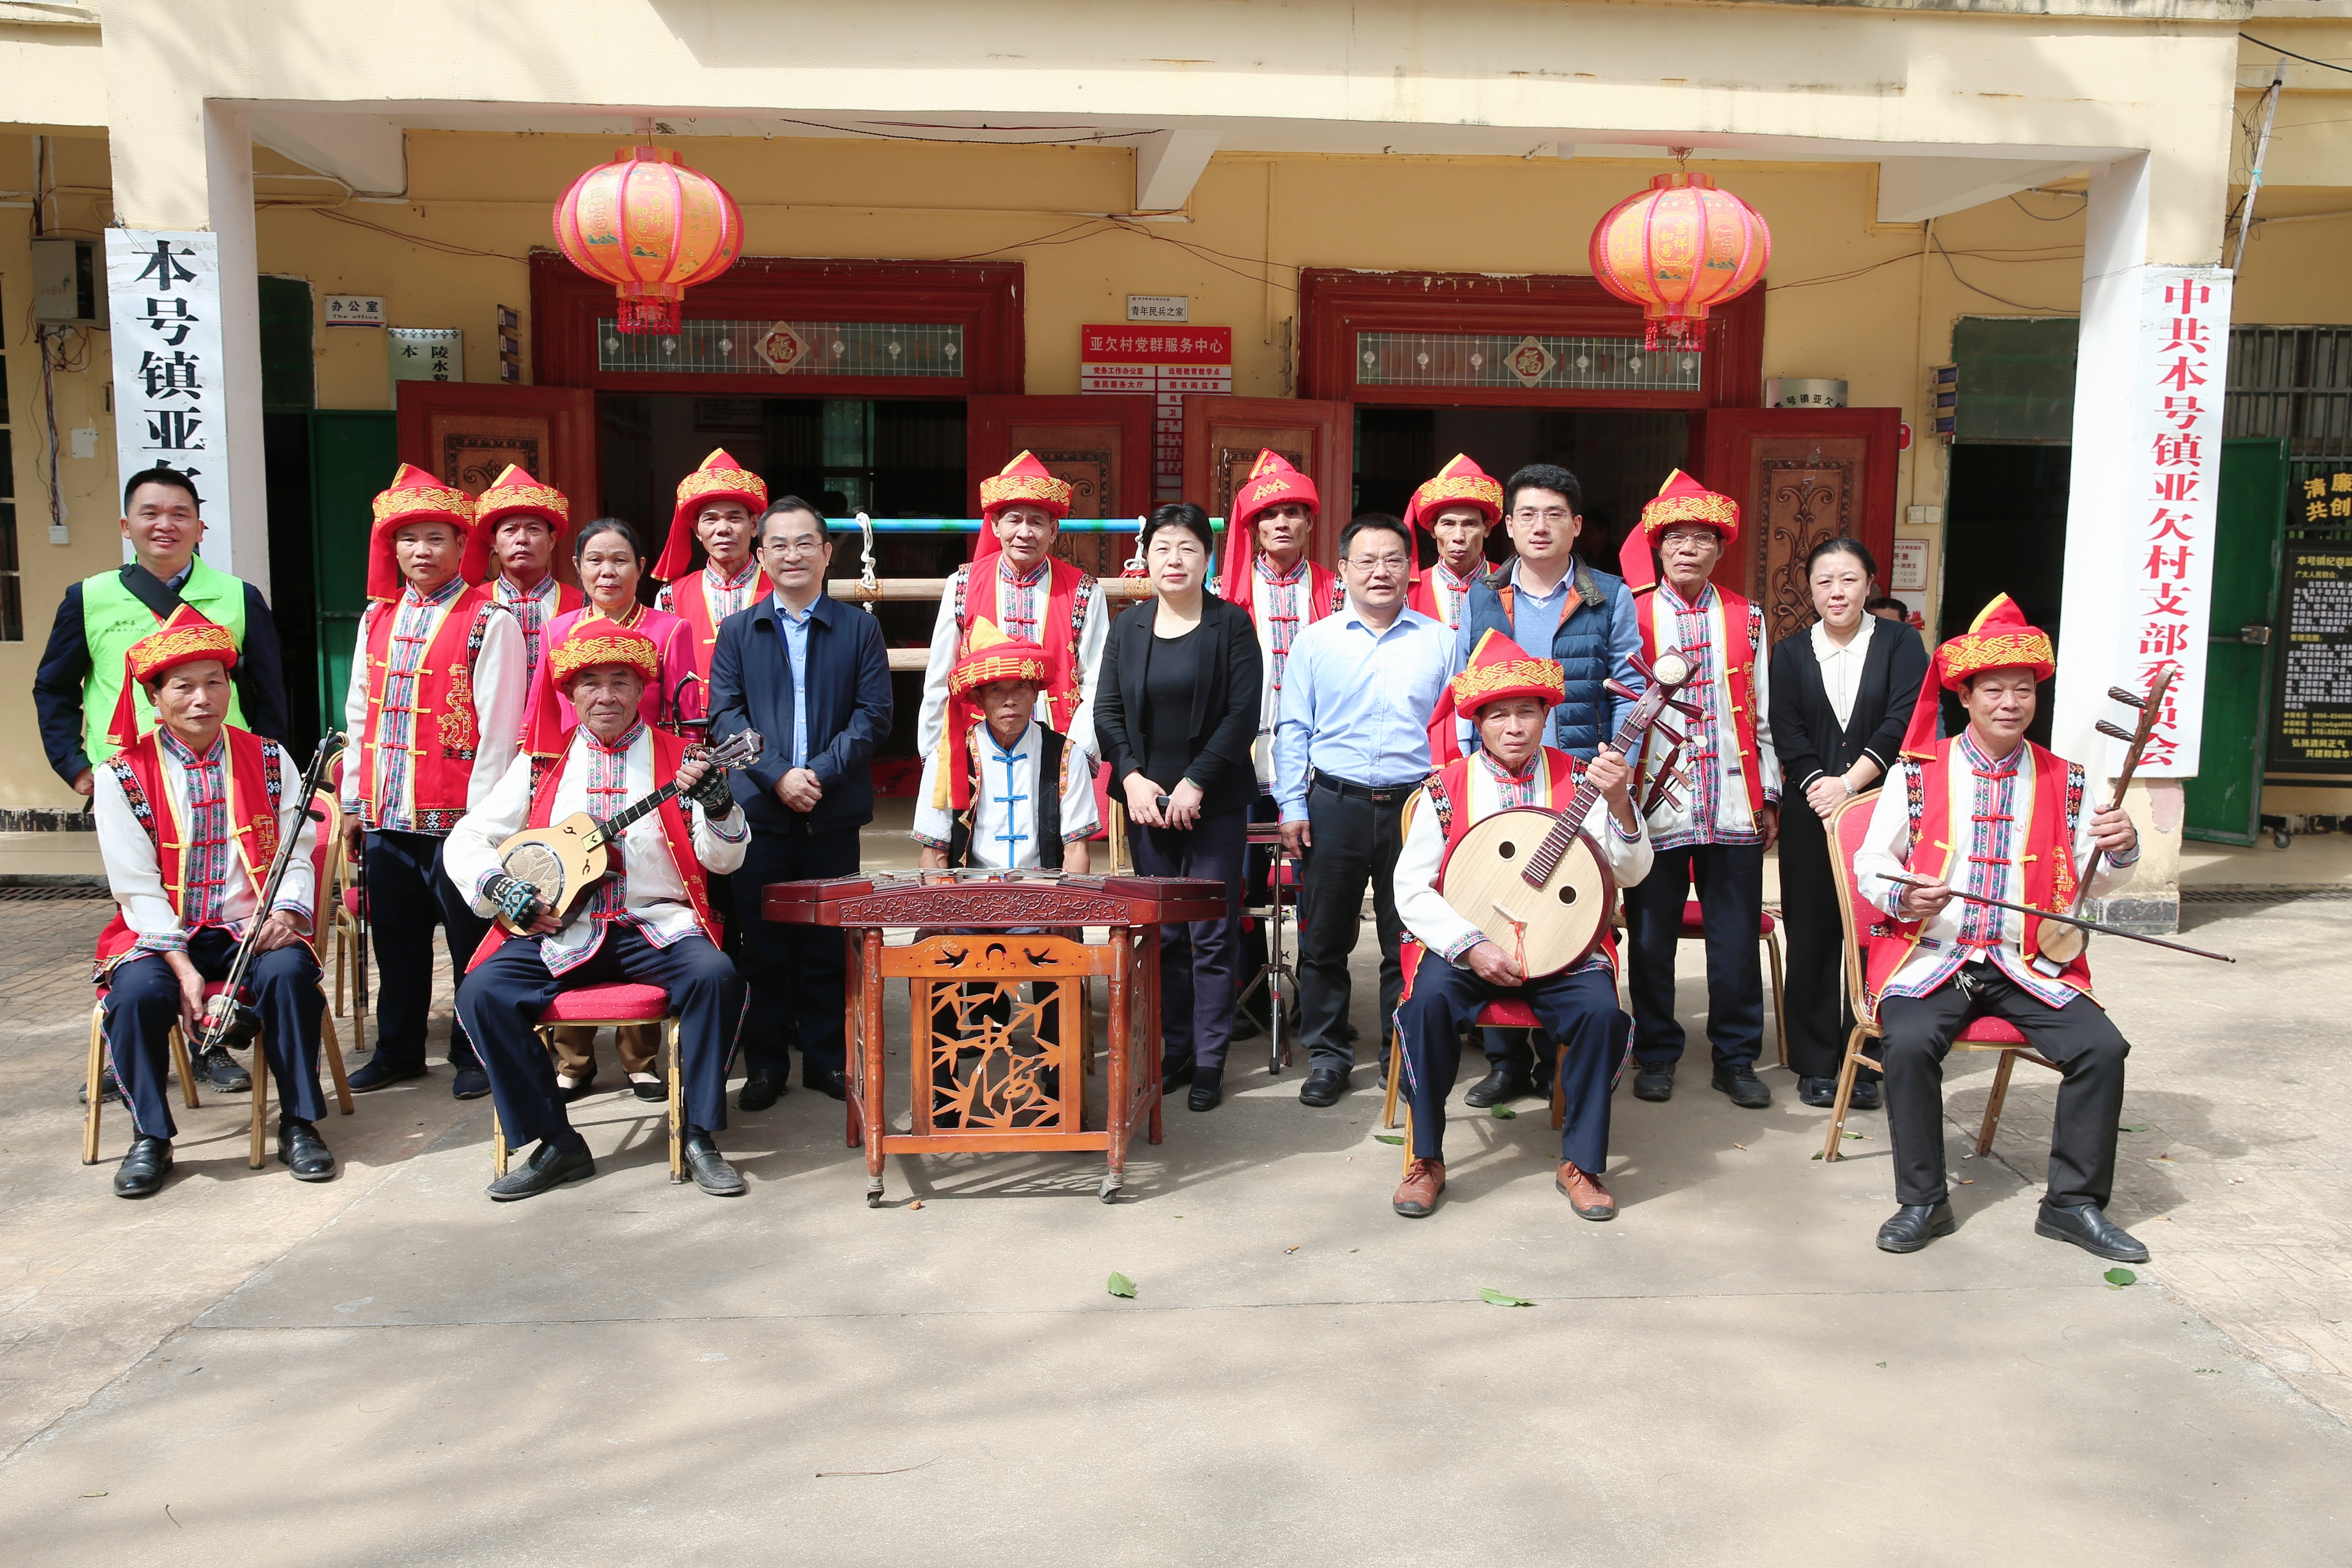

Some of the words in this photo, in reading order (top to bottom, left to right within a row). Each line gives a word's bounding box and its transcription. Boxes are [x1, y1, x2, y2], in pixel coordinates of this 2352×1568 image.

[586, 202, 608, 231] 福
[1712, 228, 1735, 257] 福
[331, 300, 379, 312] 办公室
[1131, 305, 1184, 318] 青年民兵之家
[400, 345, 419, 358] 本
[768, 335, 795, 360] 福
[1090, 336, 1224, 354] 亚欠村党群服务中心
[1517, 350, 1542, 373] 福
[1093, 366, 1144, 375] 党务工作办公室
[1168, 367, 1220, 375] 远程教育教学点
[1093, 380, 1144, 388] 便民服务大厅
[1169, 381, 1219, 389] 图书阅览室
[2303, 472, 2352, 500] 清廉
[2305, 497, 2351, 522] 共创
[2305, 749, 2352, 758] 共建和谐本
